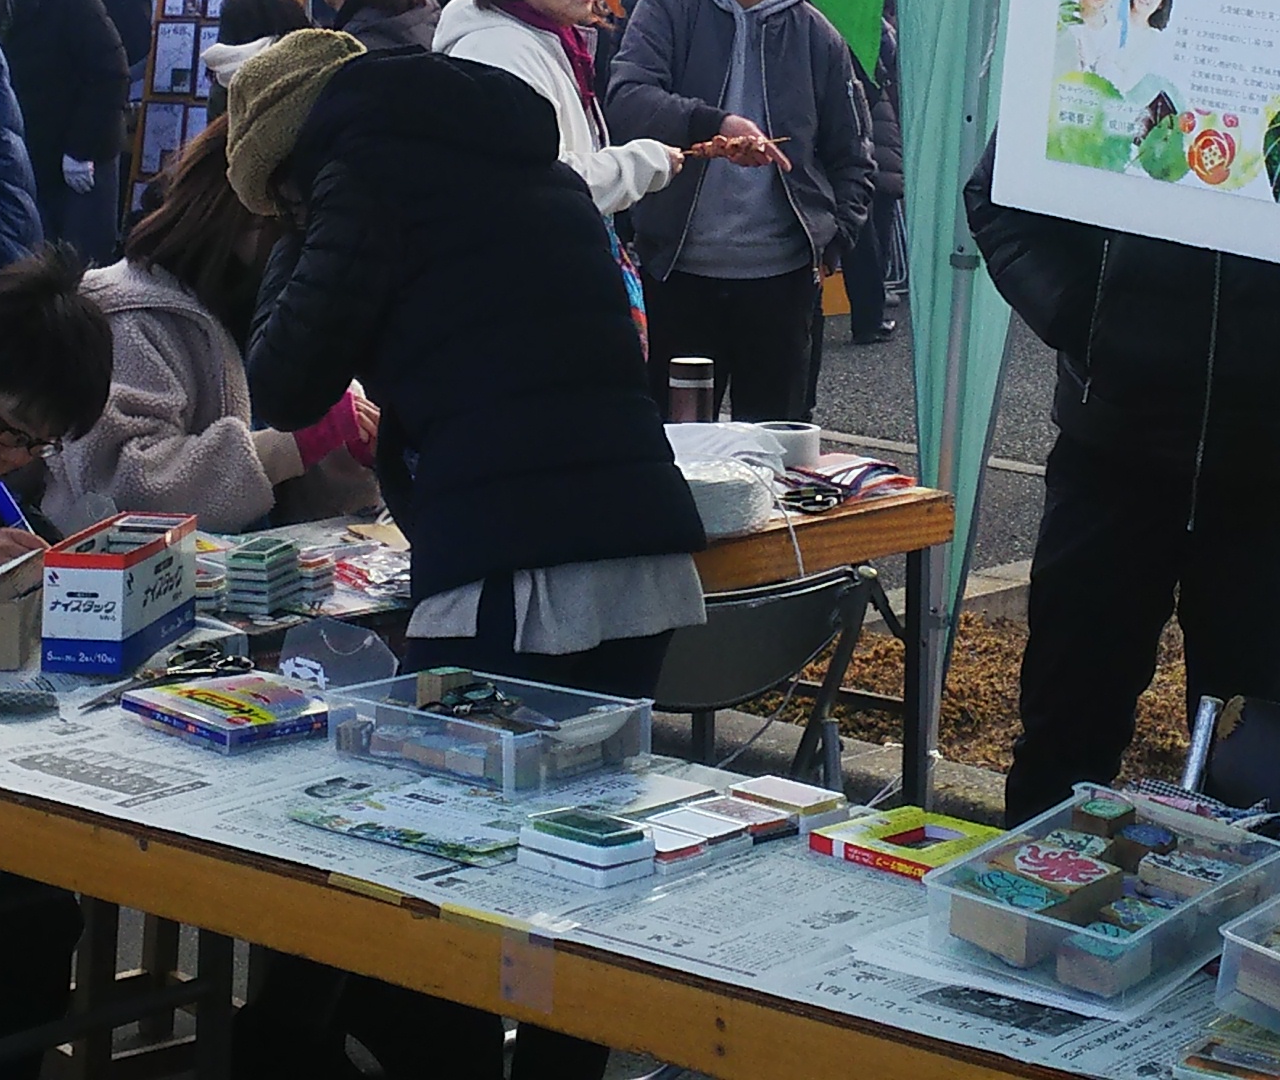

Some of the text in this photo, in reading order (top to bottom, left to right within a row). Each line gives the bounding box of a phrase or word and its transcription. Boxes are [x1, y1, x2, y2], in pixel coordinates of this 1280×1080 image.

[49, 599, 117, 614] ナイスタック
